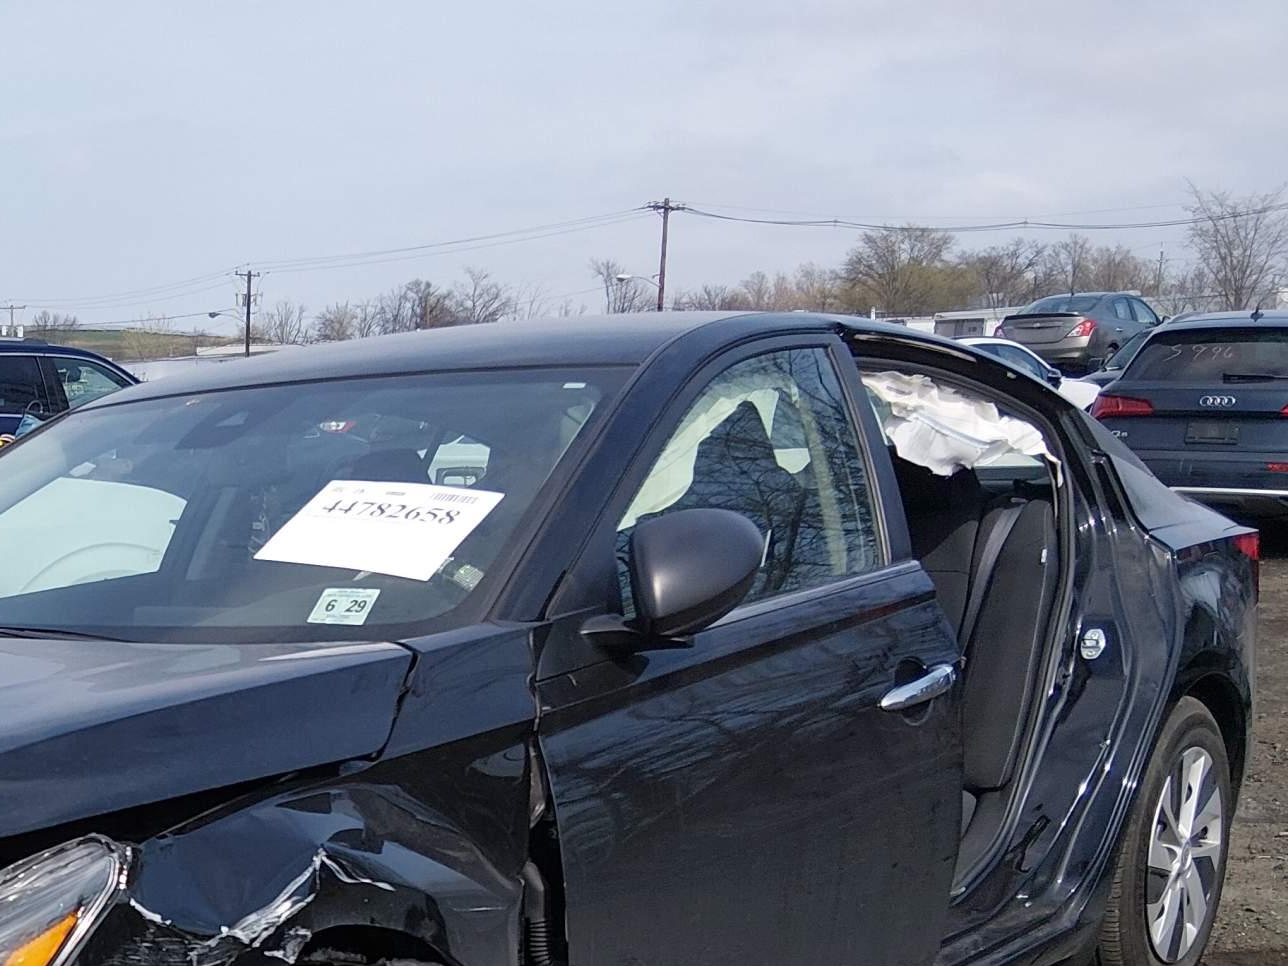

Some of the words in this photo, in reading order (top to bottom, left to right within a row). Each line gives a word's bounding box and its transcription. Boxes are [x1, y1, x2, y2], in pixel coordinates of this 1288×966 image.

[323, 500, 461, 525] 44782658
[325, 599, 338, 612] 6
[344, 600, 368, 613] 29
